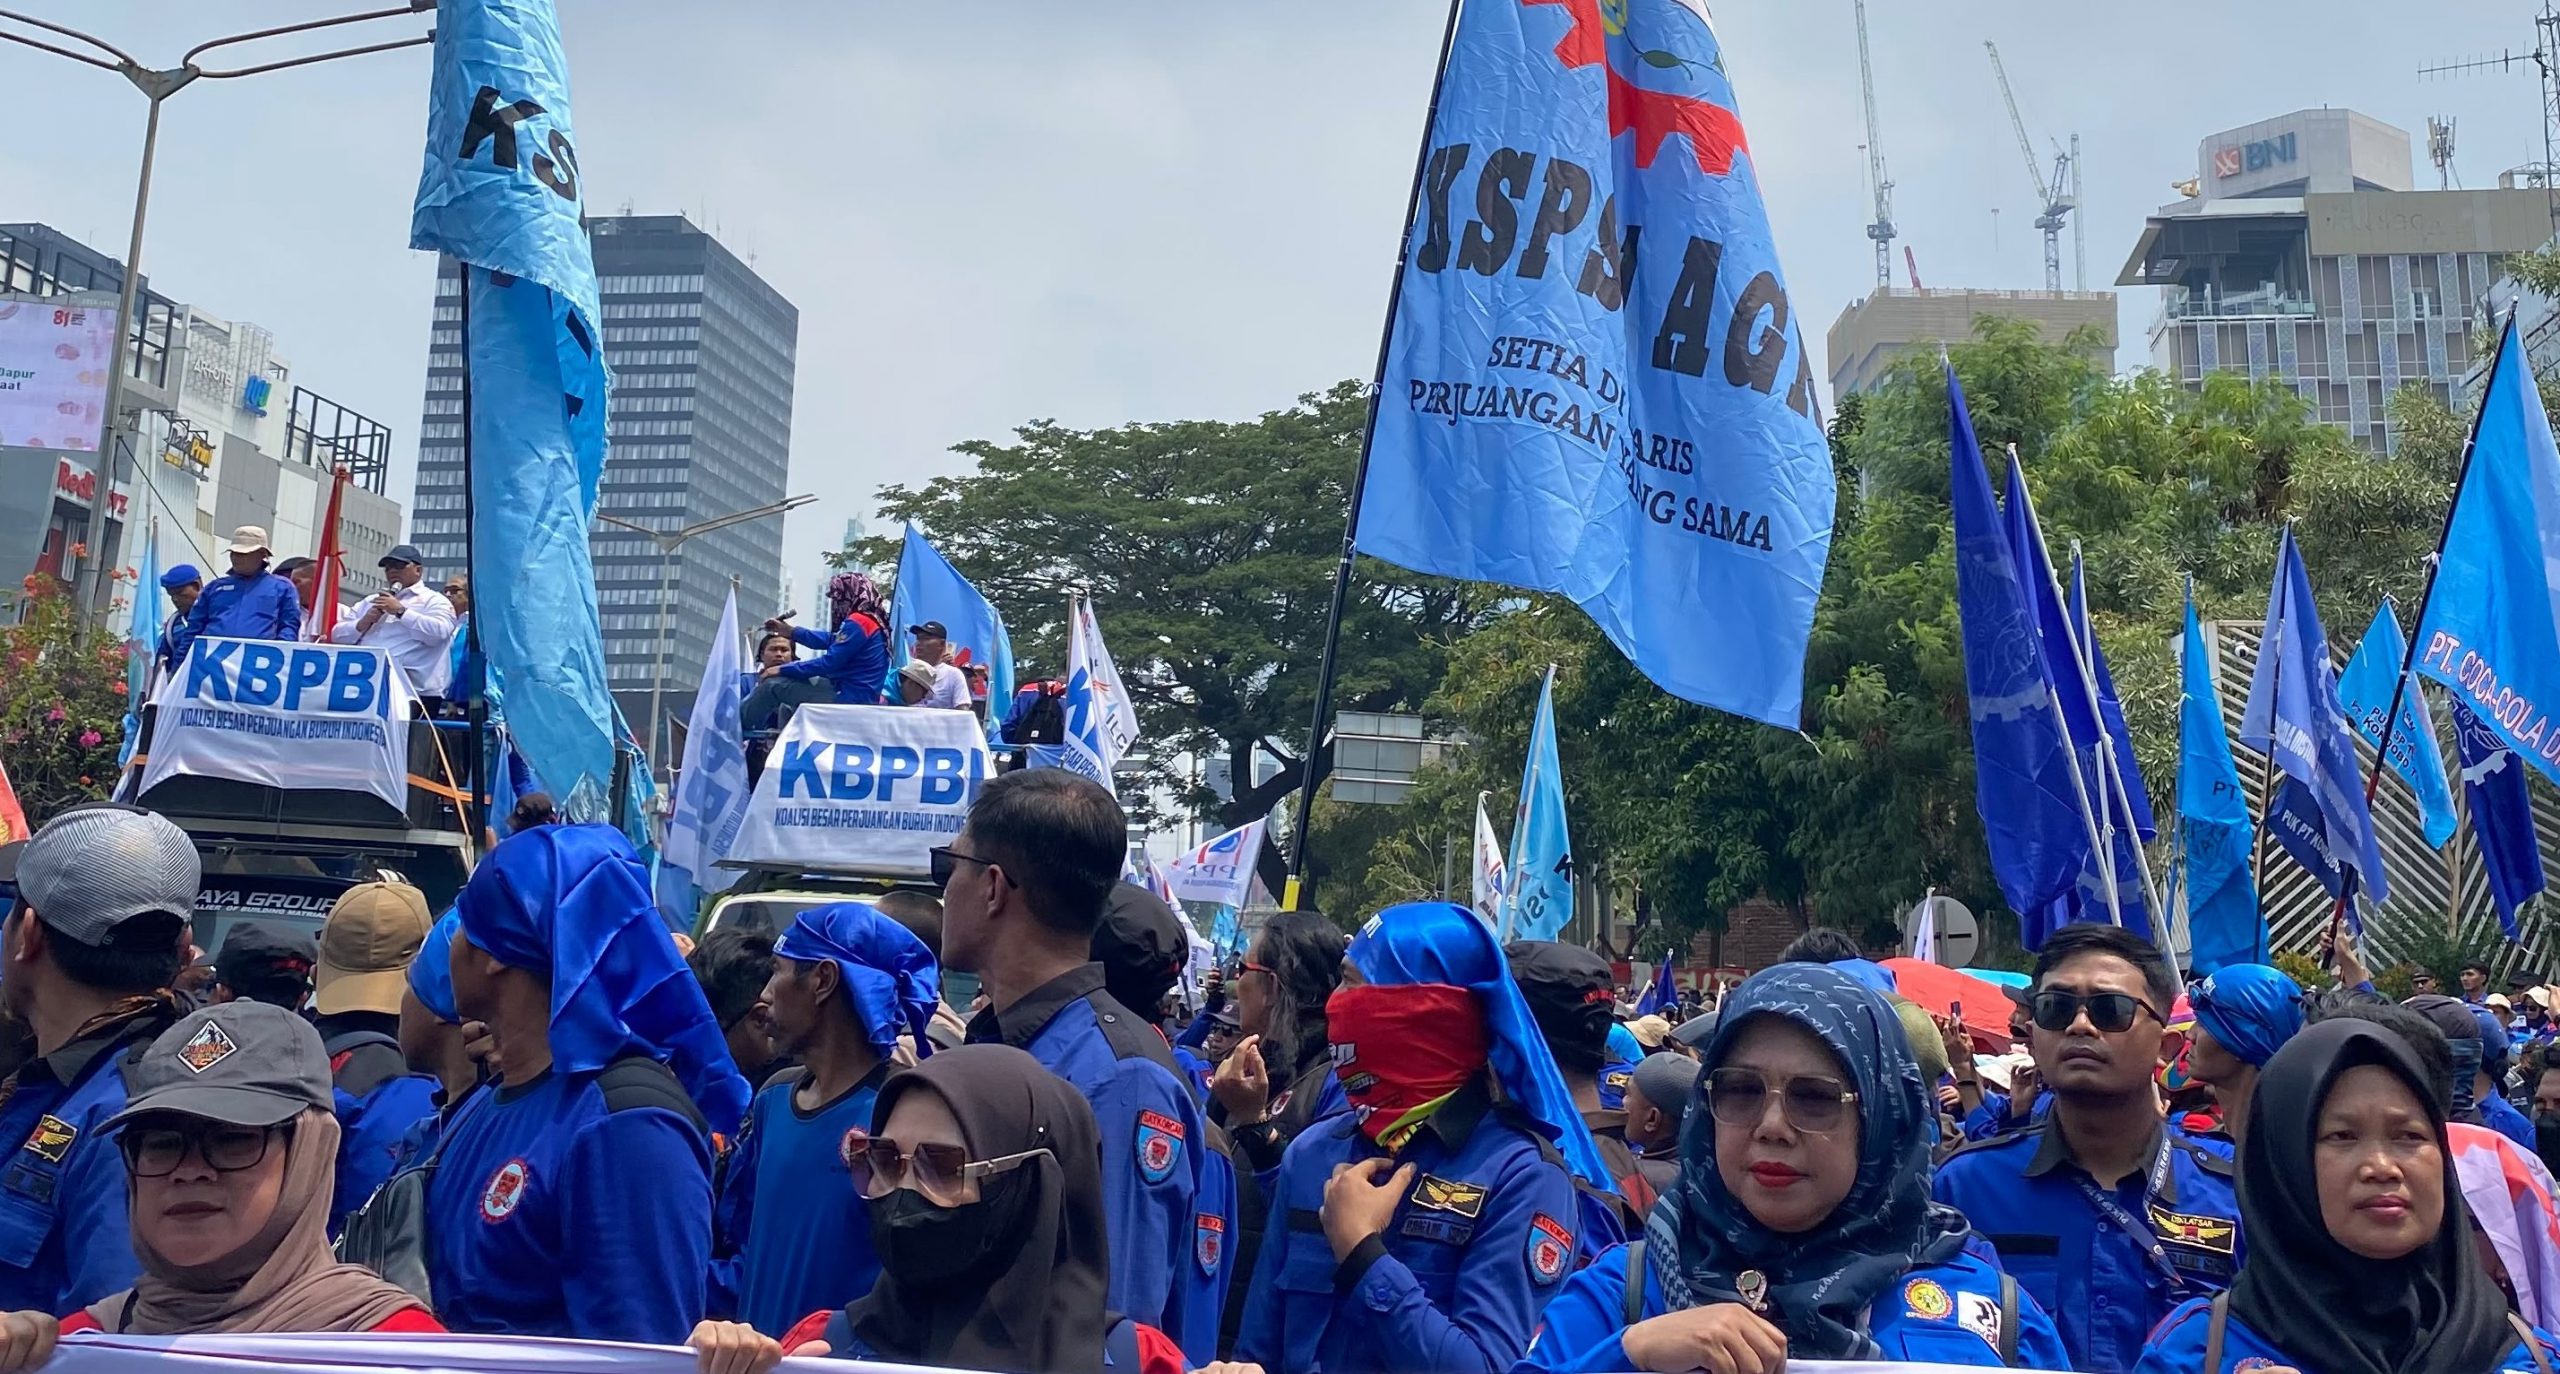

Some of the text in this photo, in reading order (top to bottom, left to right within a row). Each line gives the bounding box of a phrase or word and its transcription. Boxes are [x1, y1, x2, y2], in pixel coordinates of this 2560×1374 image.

[2244, 131, 2297, 172] BNI
[1487, 335, 1589, 391] SETIA
[1683, 496, 1773, 552] SAMA
[185, 639, 390, 724] KBPBI
[2423, 630, 2461, 674] PT.
[2458, 649, 2548, 750] COCA-COLA
[179, 708, 215, 727] KOALISI
[216, 710, 246, 731] BESAR
[247, 714, 307, 739] PERJUANGAN
[308, 720, 340, 739] BURUH
[778, 739, 985, 806] KBPBI
[2213, 780, 2240, 802] PT.
[774, 807, 810, 826] KOALISI
[811, 808, 840, 828] BESAR
[841, 808, 901, 830] PERJUANGAN
[902, 811, 933, 832] BURUH
[2281, 809, 2302, 834] PUK
[2296, 822, 2313, 842] PT
[240, 906, 286, 916] BUILDING
